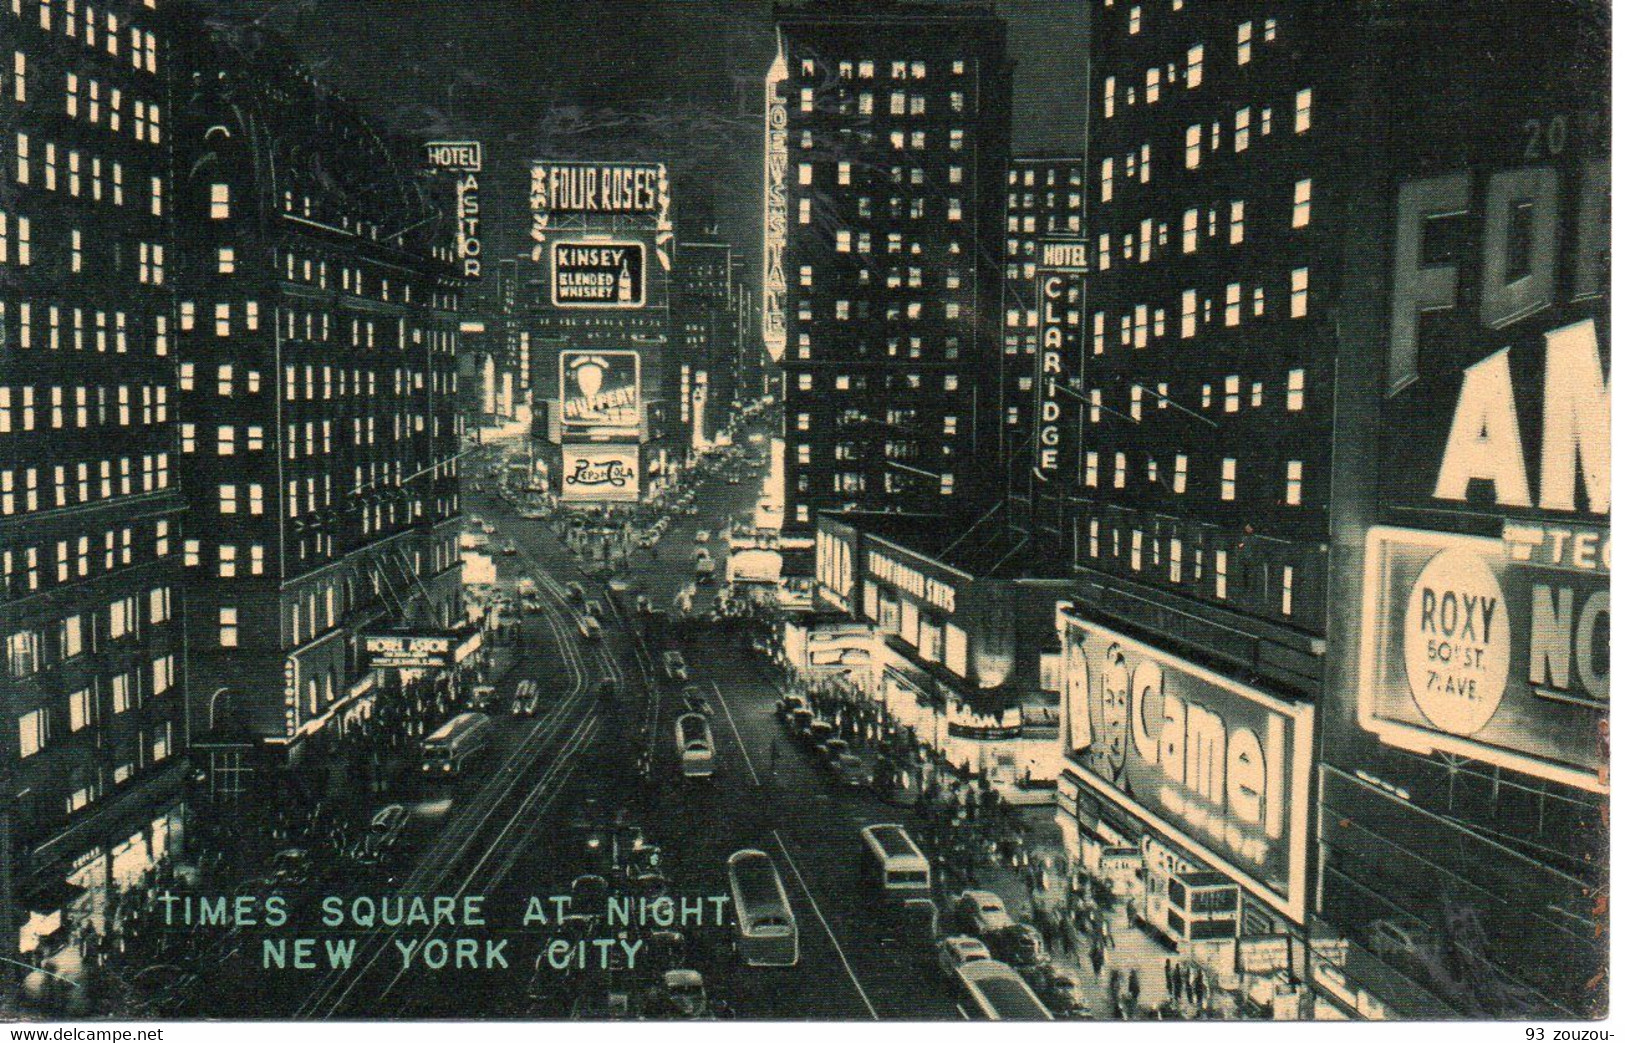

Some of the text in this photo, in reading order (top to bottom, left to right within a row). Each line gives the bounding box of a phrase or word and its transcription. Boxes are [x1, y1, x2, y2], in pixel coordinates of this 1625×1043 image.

[426, 146, 478, 167] HOTEL
[550, 167, 656, 210] FOUR ROSES
[463, 173, 480, 276] ASTOR
[557, 249, 624, 266] KINSEY
[1043, 243, 1086, 266] HOTEL
[558, 273, 614, 285] BLENDED
[559, 286, 614, 298] WHISKEY
[1041, 276, 1063, 469] CLARIDGE
[1421, 587, 1496, 644] ROXY
